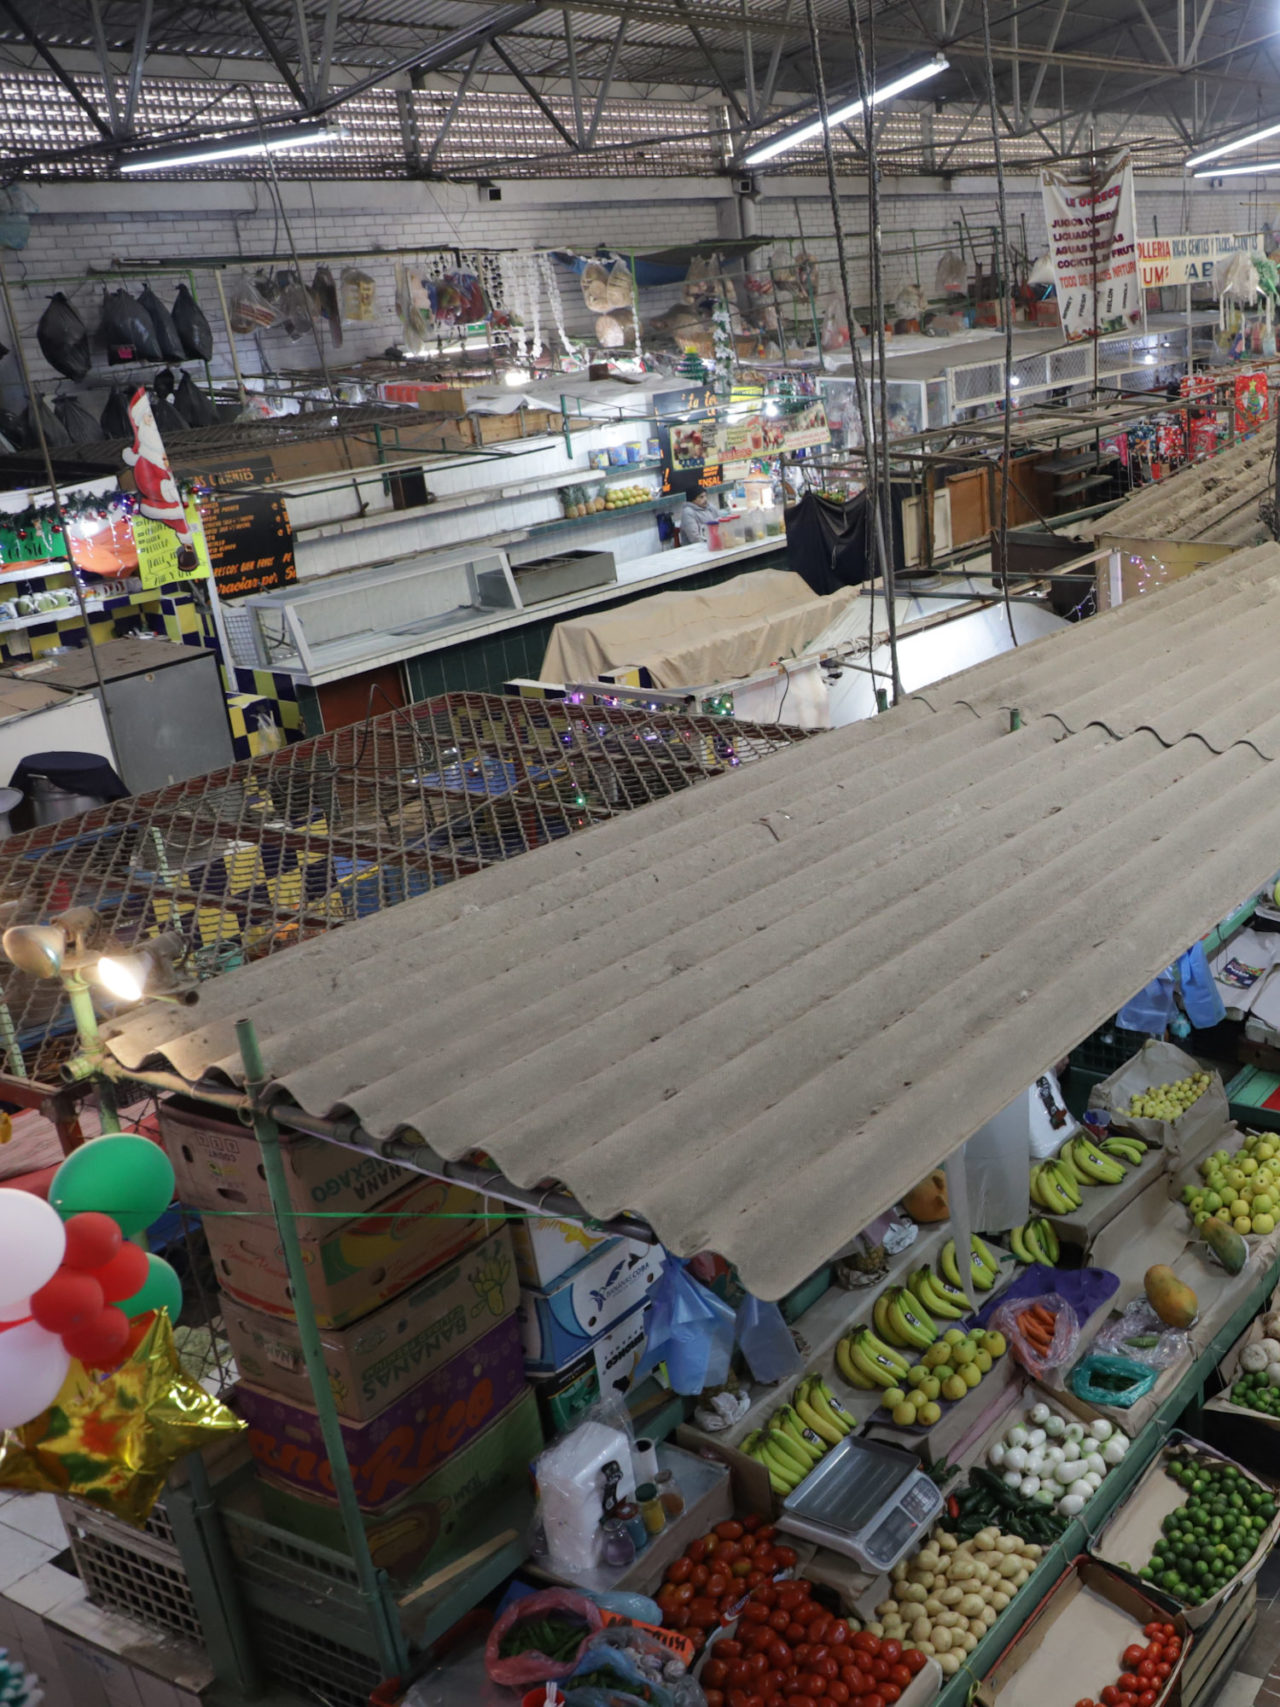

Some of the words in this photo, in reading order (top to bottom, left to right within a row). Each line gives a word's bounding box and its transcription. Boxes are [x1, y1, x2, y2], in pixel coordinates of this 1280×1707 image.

[1052, 218, 1083, 228] JUGOS
[1056, 245, 1087, 256] AGUAS
[1111, 244, 1134, 258] FRUT
[362, 1314, 467, 1402] BANANAS
